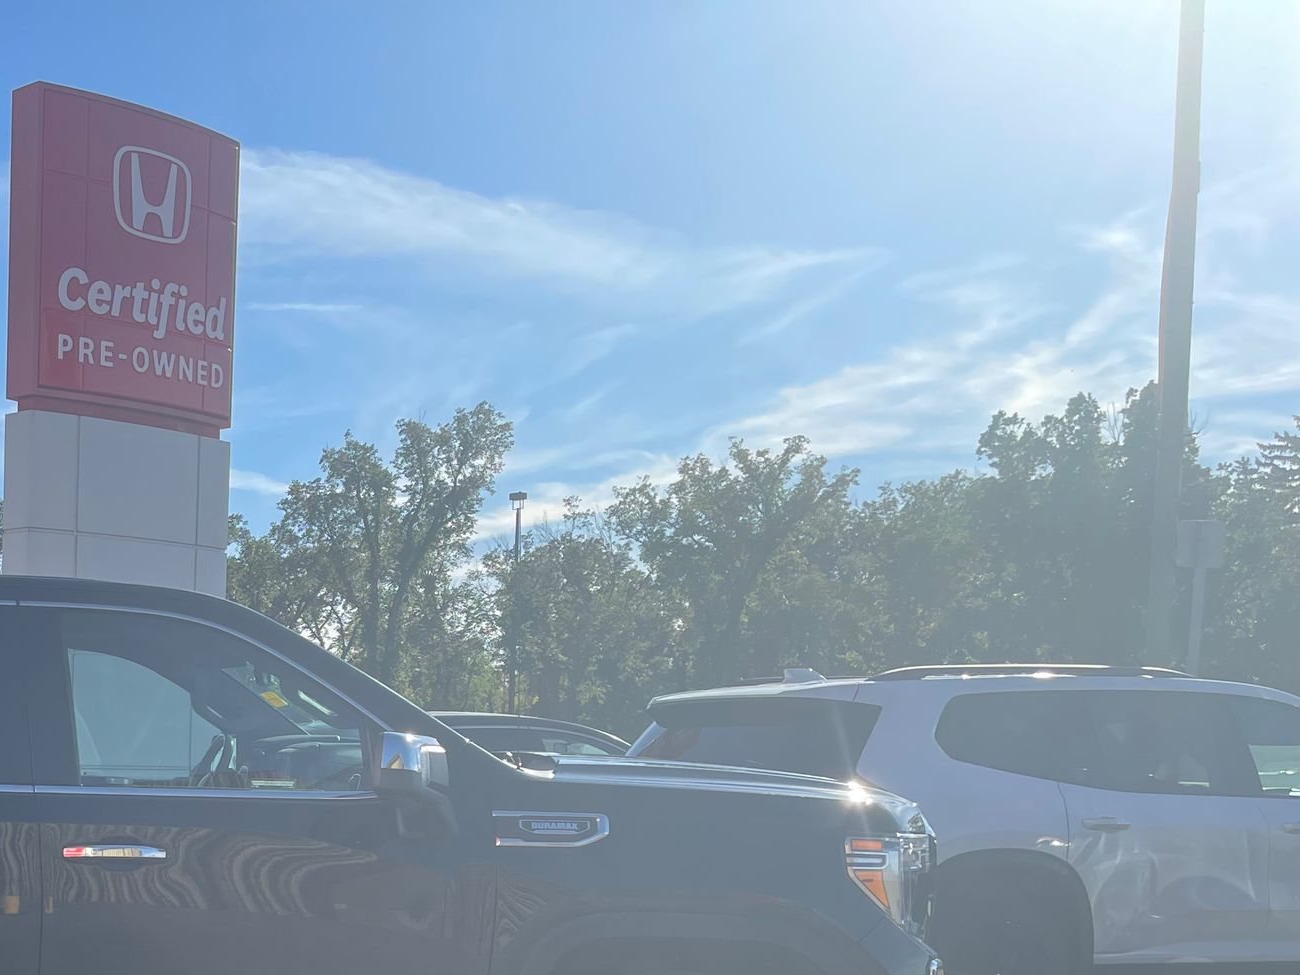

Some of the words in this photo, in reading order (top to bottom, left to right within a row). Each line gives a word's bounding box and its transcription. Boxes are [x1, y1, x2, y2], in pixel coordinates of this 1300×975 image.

[58, 266, 227, 341] Certified
[57, 333, 224, 389] PRE-OWNED
[532, 822, 578, 830] DURAMAX
